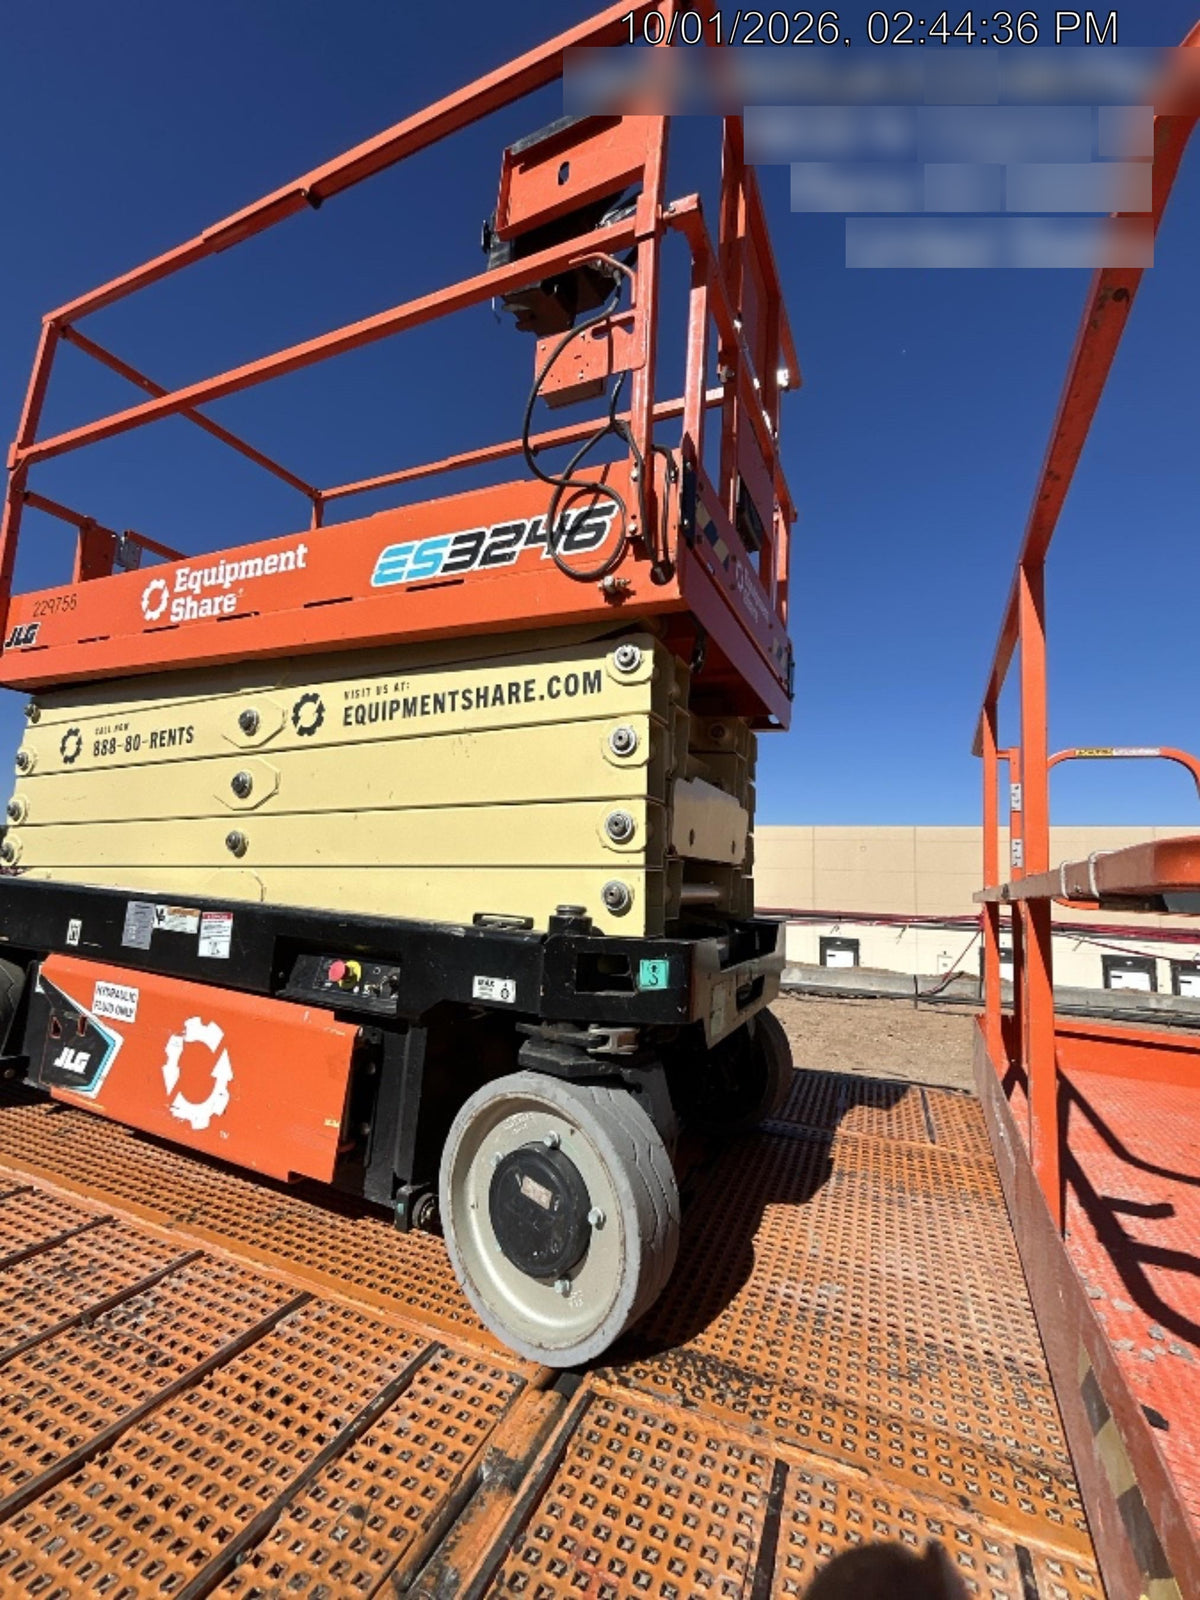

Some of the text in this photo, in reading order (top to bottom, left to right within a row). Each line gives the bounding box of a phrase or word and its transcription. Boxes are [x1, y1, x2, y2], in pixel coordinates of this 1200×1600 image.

[371, 501, 619, 587] ES3246
[174, 543, 308, 594] Equipment
[170, 593, 237, 622] Share
[4, 623, 40, 648] JLG
[343, 669, 601, 726] EQUIPMENTSHARE.COM
[344, 681, 410, 700] VISIT US AT:
[93, 724, 194, 756] 888-80-RENTS
[53, 1046, 91, 1074] JLG
